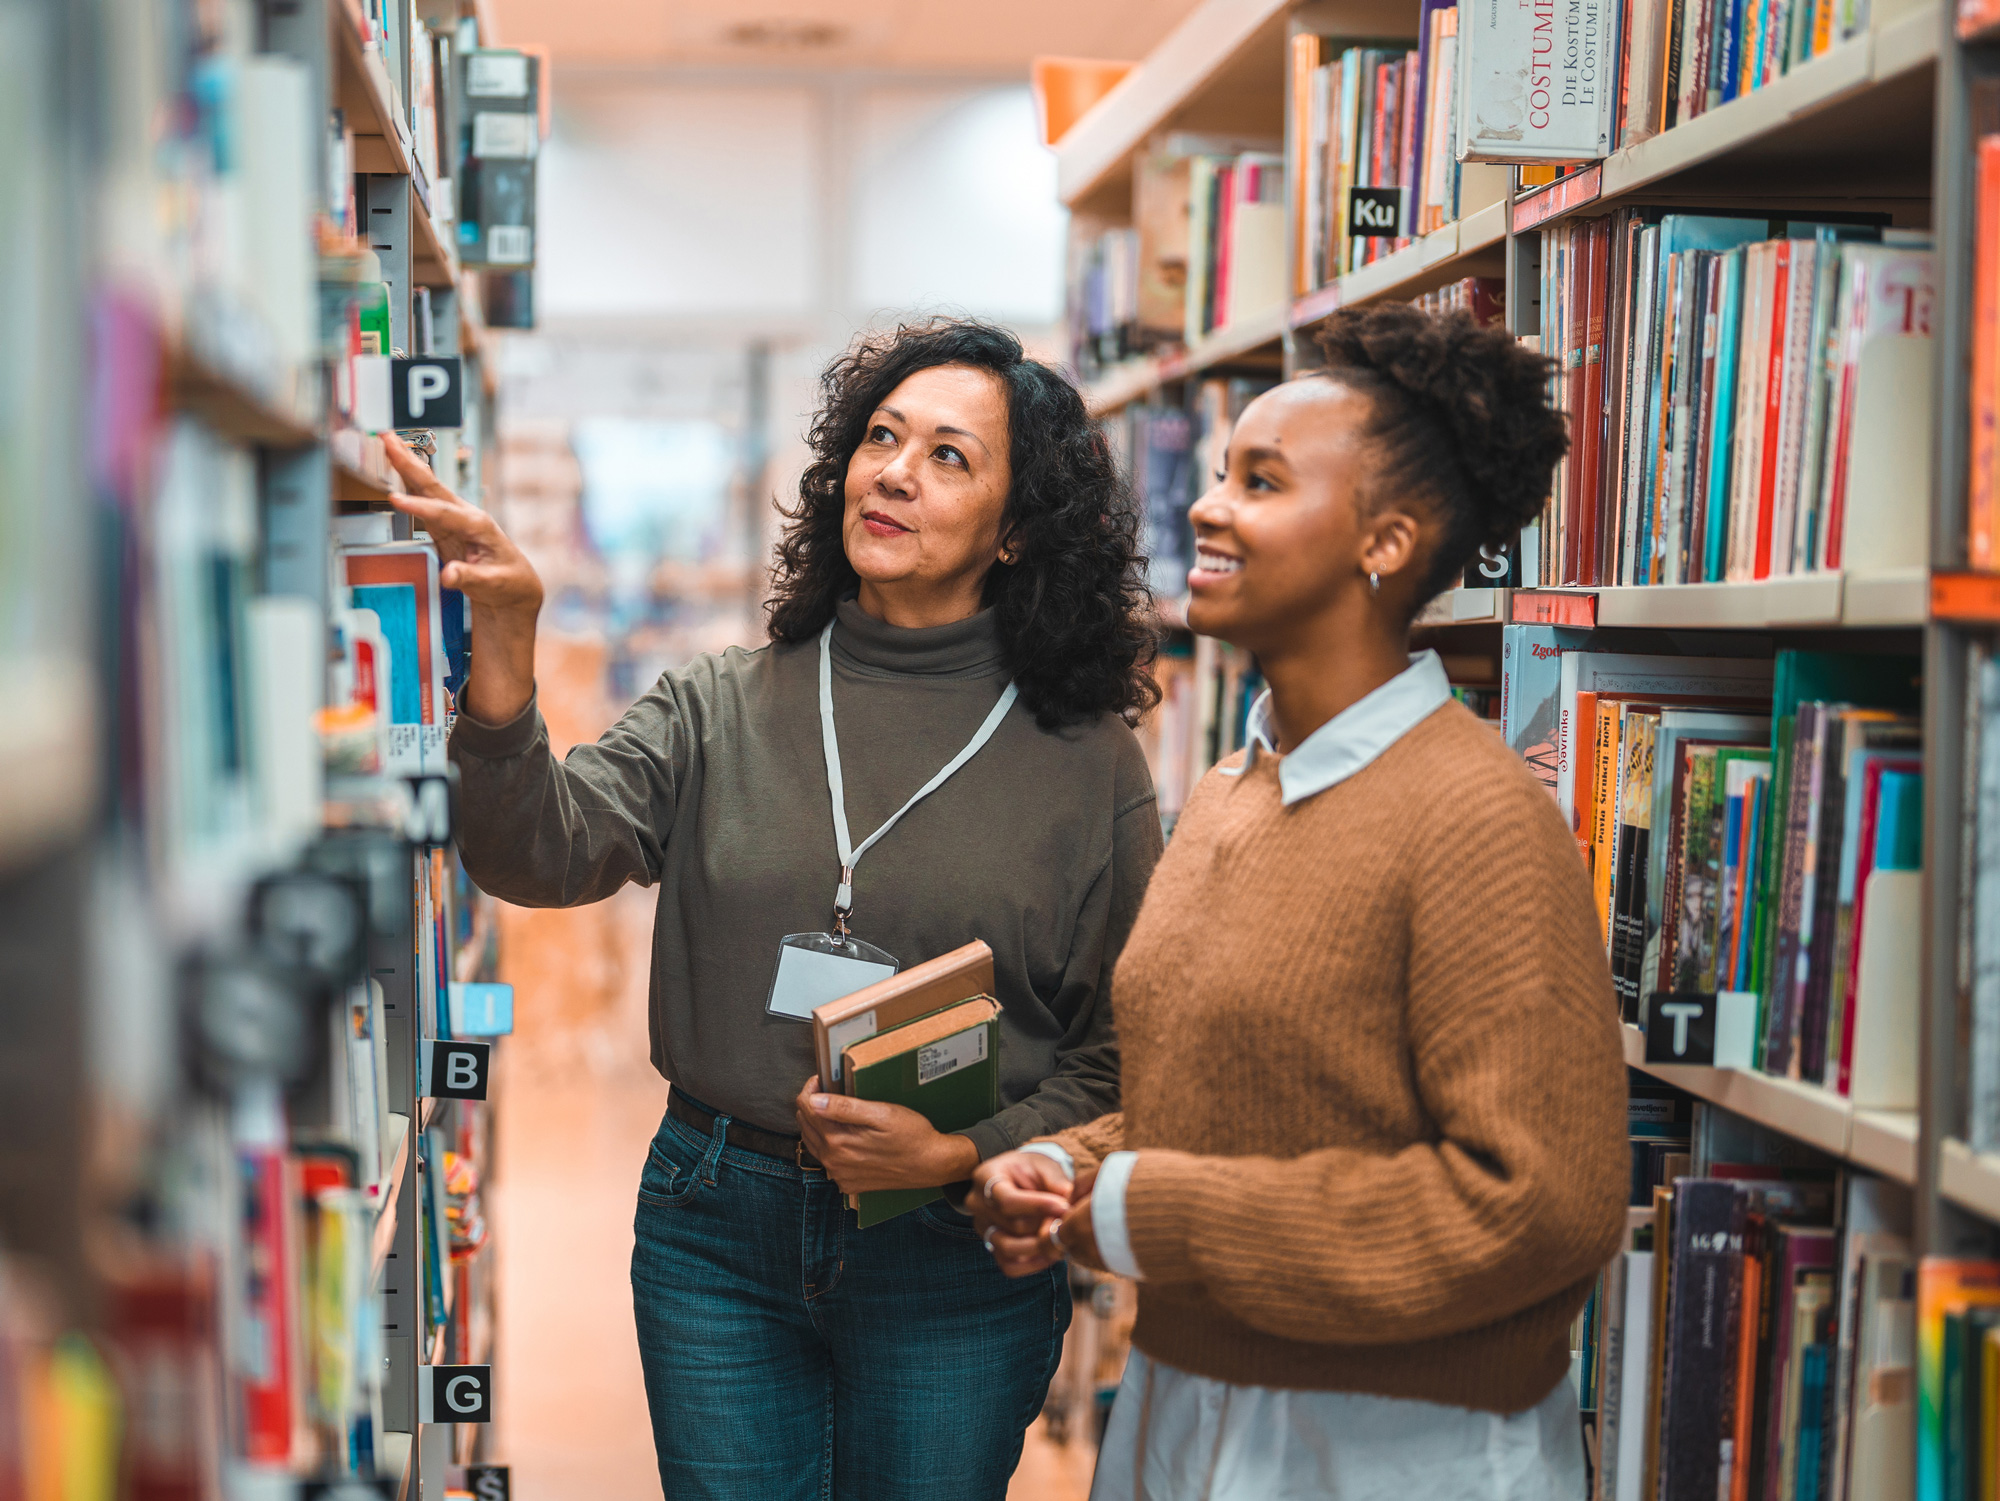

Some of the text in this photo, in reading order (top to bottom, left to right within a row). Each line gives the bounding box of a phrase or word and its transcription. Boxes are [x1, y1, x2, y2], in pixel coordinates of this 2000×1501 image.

[1580, 2, 1598, 81] COSTUME
[1355, 199, 1395, 229] Ku
[407, 365, 449, 418] P
[1598, 810, 1606, 845] Pavla
[1660, 1003, 1704, 1057] T
[446, 1051, 479, 1090] B
[445, 1375, 482, 1414] G
[475, 1468, 505, 1501] Š
